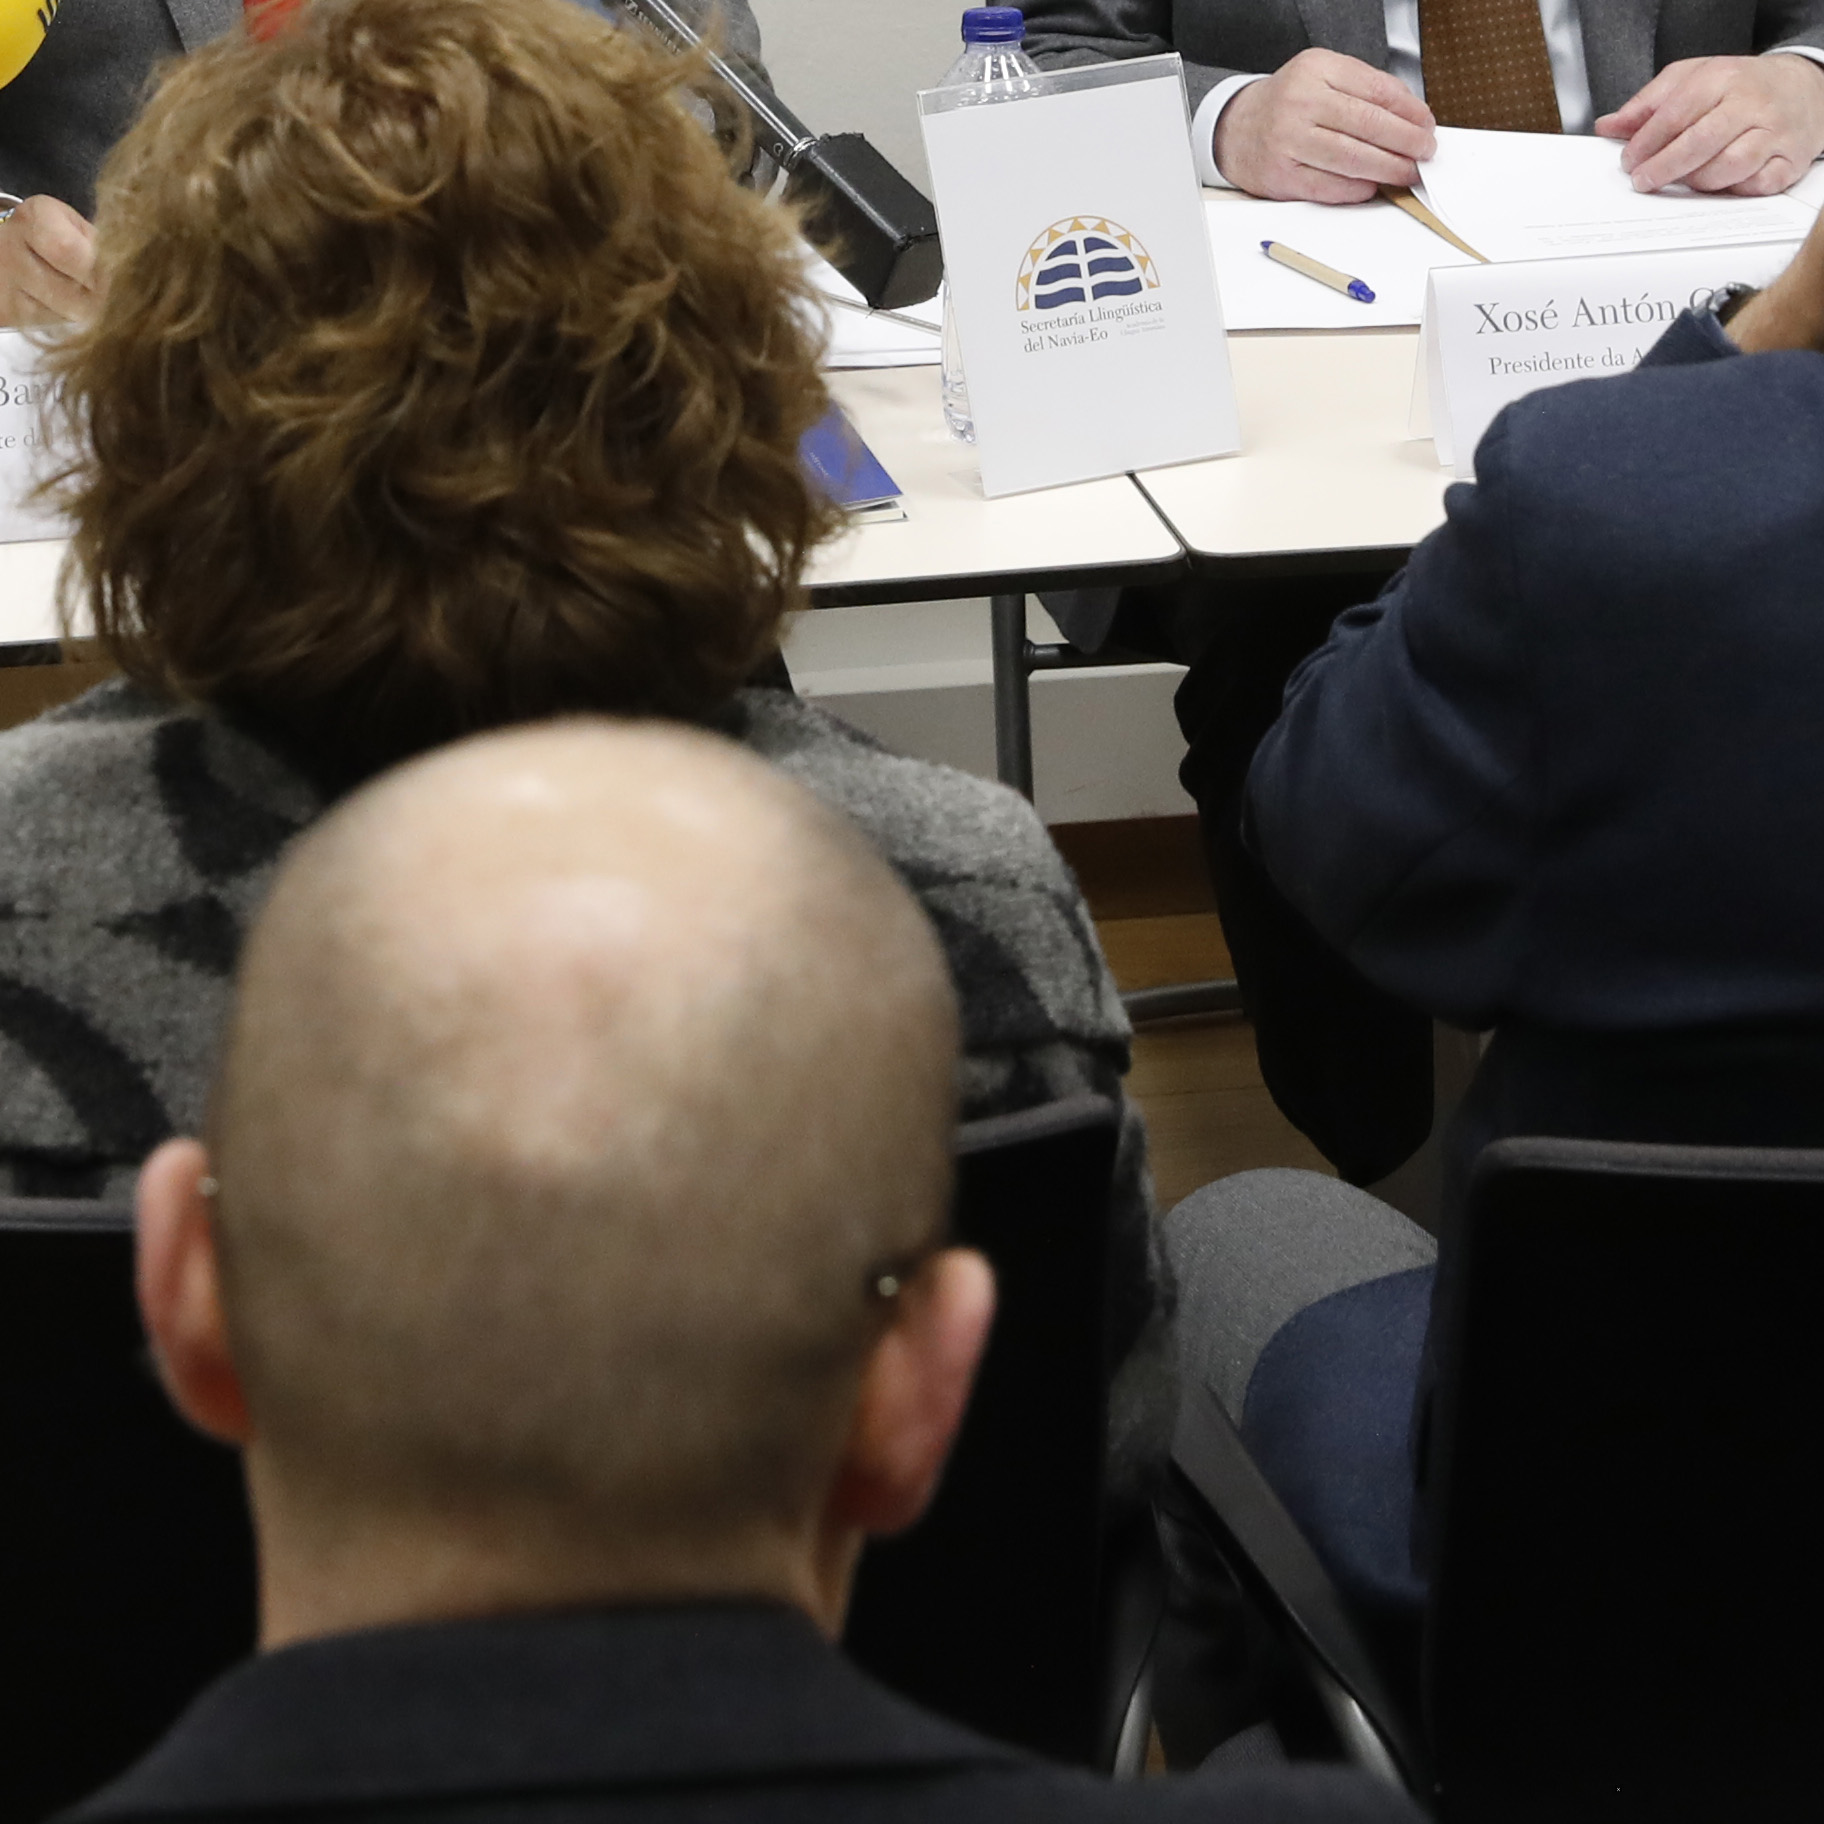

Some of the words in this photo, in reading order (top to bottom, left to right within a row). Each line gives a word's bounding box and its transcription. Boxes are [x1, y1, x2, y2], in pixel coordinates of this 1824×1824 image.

[1020, 311, 1085, 335] Secretaría
[1088, 300, 1163, 323] Llingüística
[1473, 298, 1560, 335] Xosé
[1571, 292, 1677, 329] Antón
[1023, 335, 1045, 354] del
[1047, 327, 1109, 350] Navia-Eo
[1488, 351, 1596, 376] Presidente
[1601, 347, 1626, 369] da
